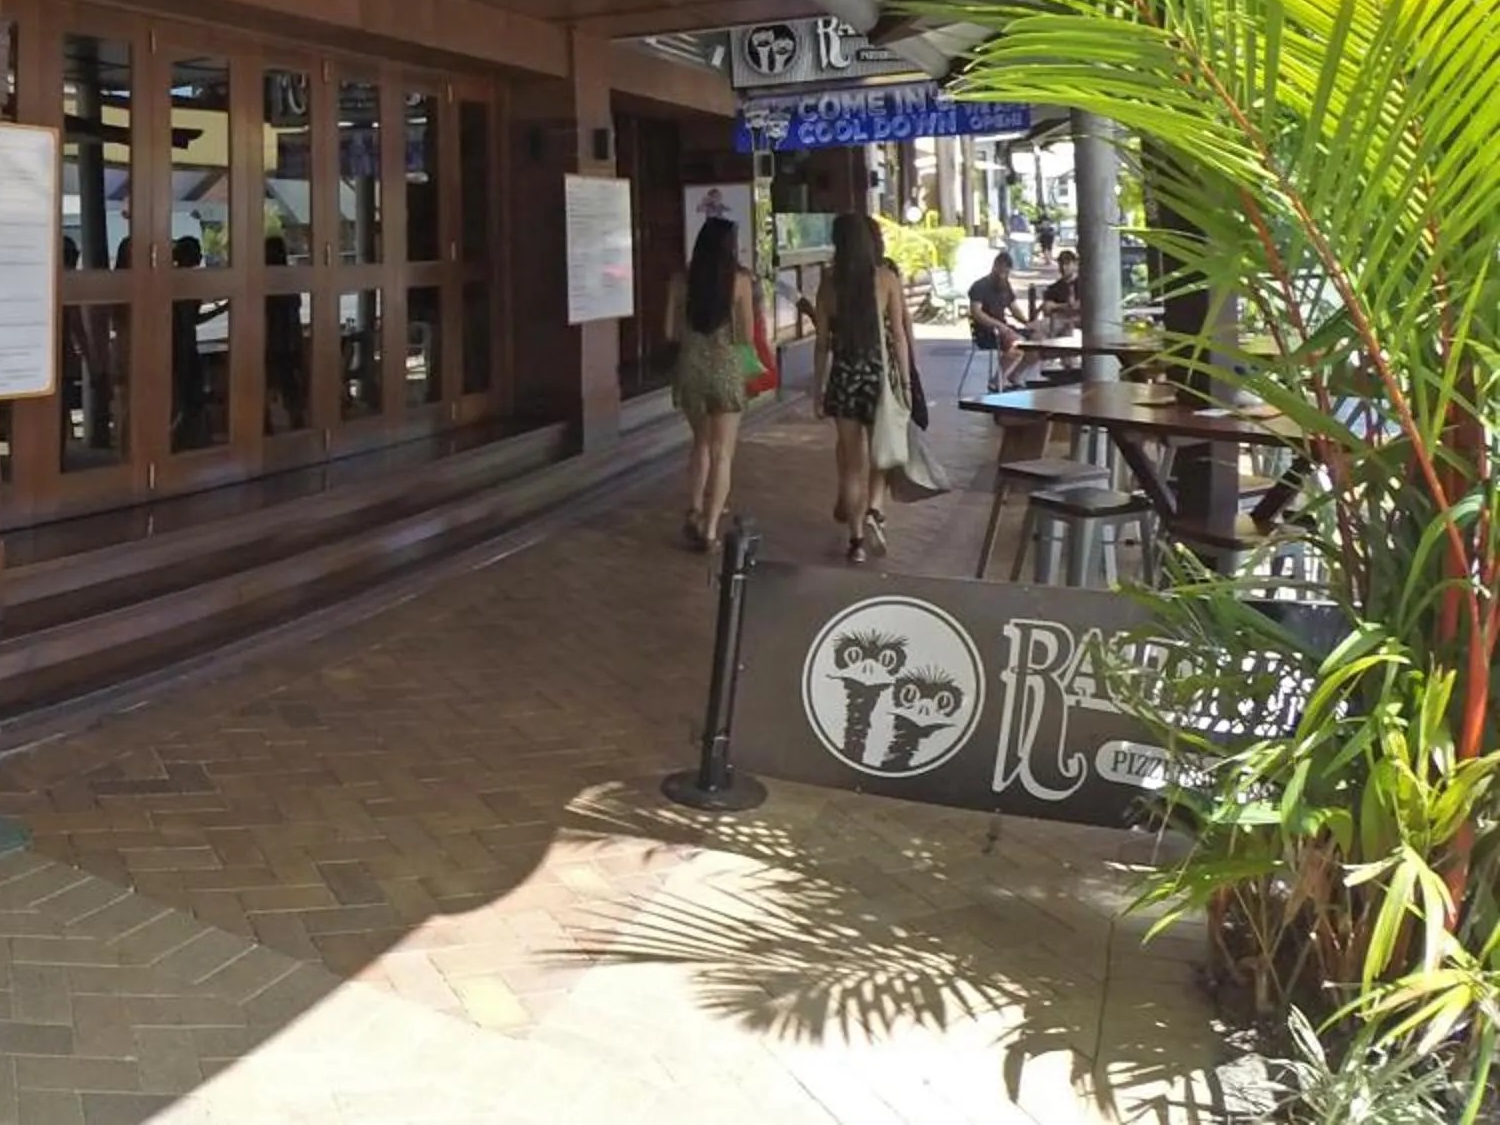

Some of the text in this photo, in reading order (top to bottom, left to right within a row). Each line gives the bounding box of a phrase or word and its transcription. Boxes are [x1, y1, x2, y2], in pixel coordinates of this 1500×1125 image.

[798, 90, 887, 121] COME
[894, 84, 927, 114] IN
[798, 112, 957, 144] COOL DOWN
